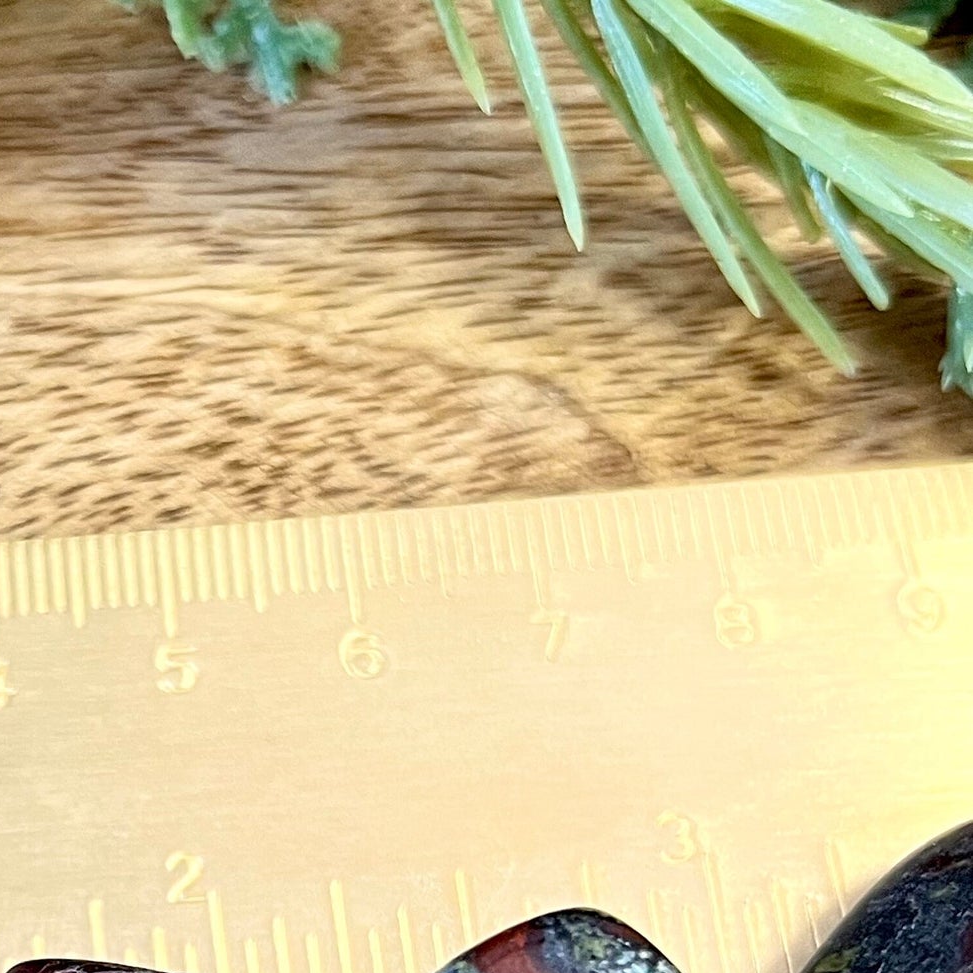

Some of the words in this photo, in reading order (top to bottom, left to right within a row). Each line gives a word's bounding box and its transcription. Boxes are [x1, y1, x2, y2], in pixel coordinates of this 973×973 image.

[154, 645, 200, 695] 5
[338, 627, 388, 680] 6
[530, 608, 569, 664] 7
[713, 597, 758, 649] 8
[897, 580, 946, 634] 9
[165, 851, 208, 903] 2
[655, 810, 701, 864] 3
